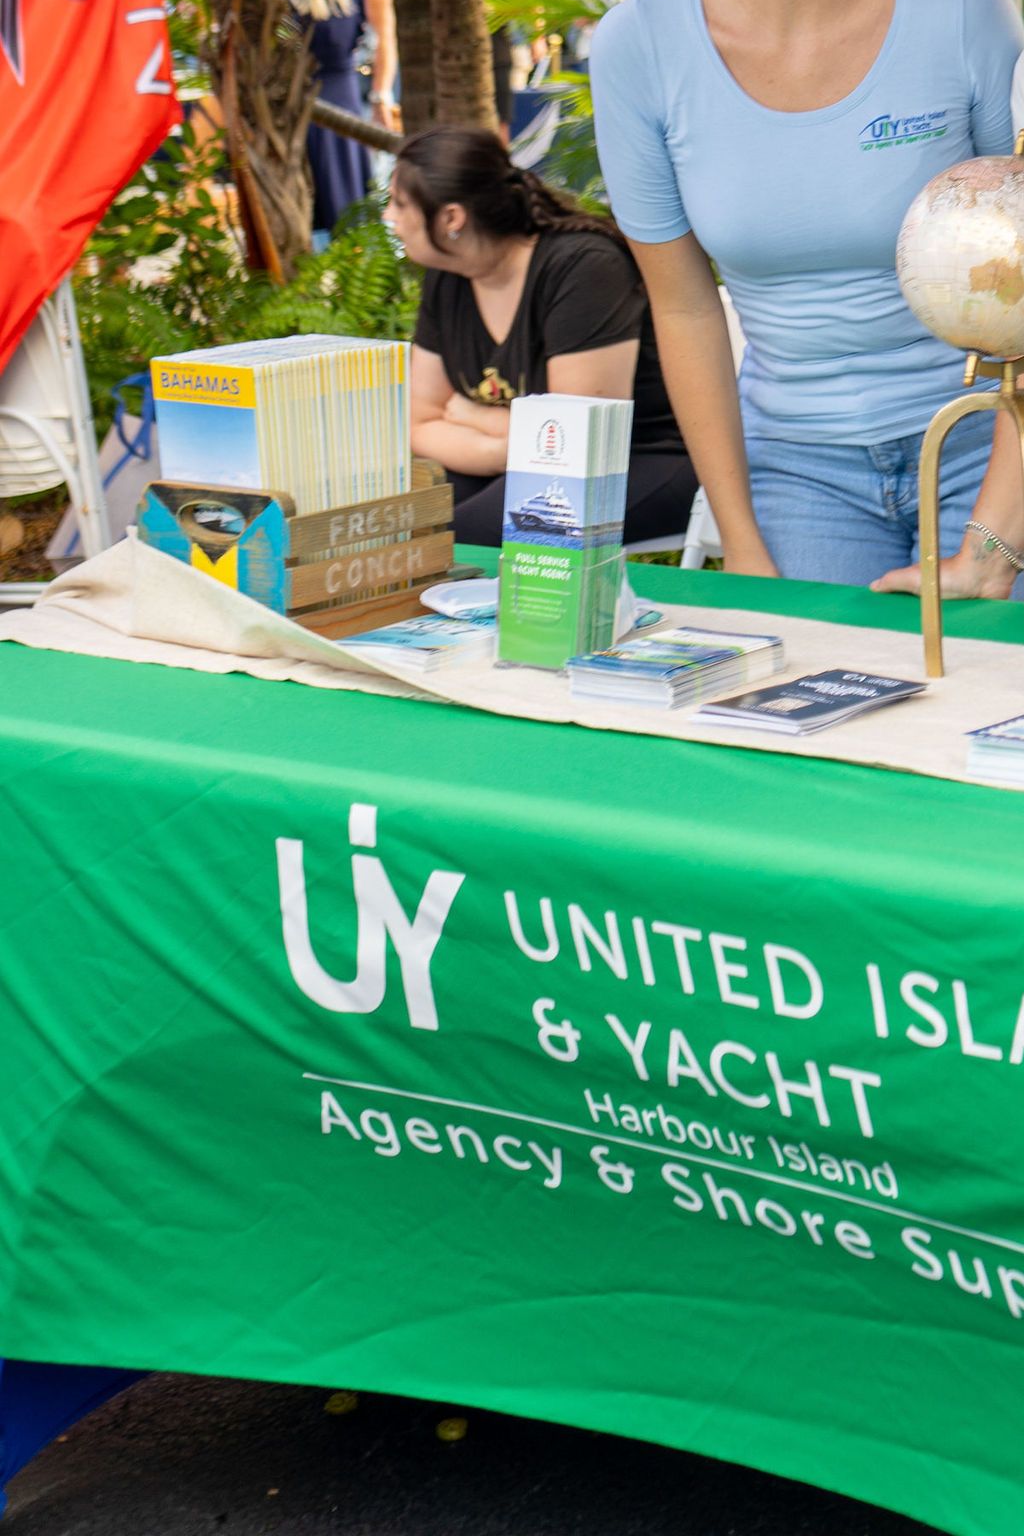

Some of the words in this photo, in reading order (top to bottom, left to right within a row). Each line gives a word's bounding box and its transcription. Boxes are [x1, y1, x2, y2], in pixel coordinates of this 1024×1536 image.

[160, 371, 241, 396] BAHAMAS
[329, 503, 416, 546] FRESH
[514, 552, 536, 565] FULL
[537, 554, 571, 569] SERVICE
[325, 545, 423, 594] CONCH
[505, 892, 823, 1019] UNITED
[532, 998, 581, 1062] &
[606, 1015, 881, 1138] YACHT
[319, 1090, 564, 1189] Agency
[590, 1146, 635, 1194] &
[672, 1165, 873, 1260] Shore
[584, 1090, 756, 1160] Harbour
[769, 1137, 898, 1200] Island
